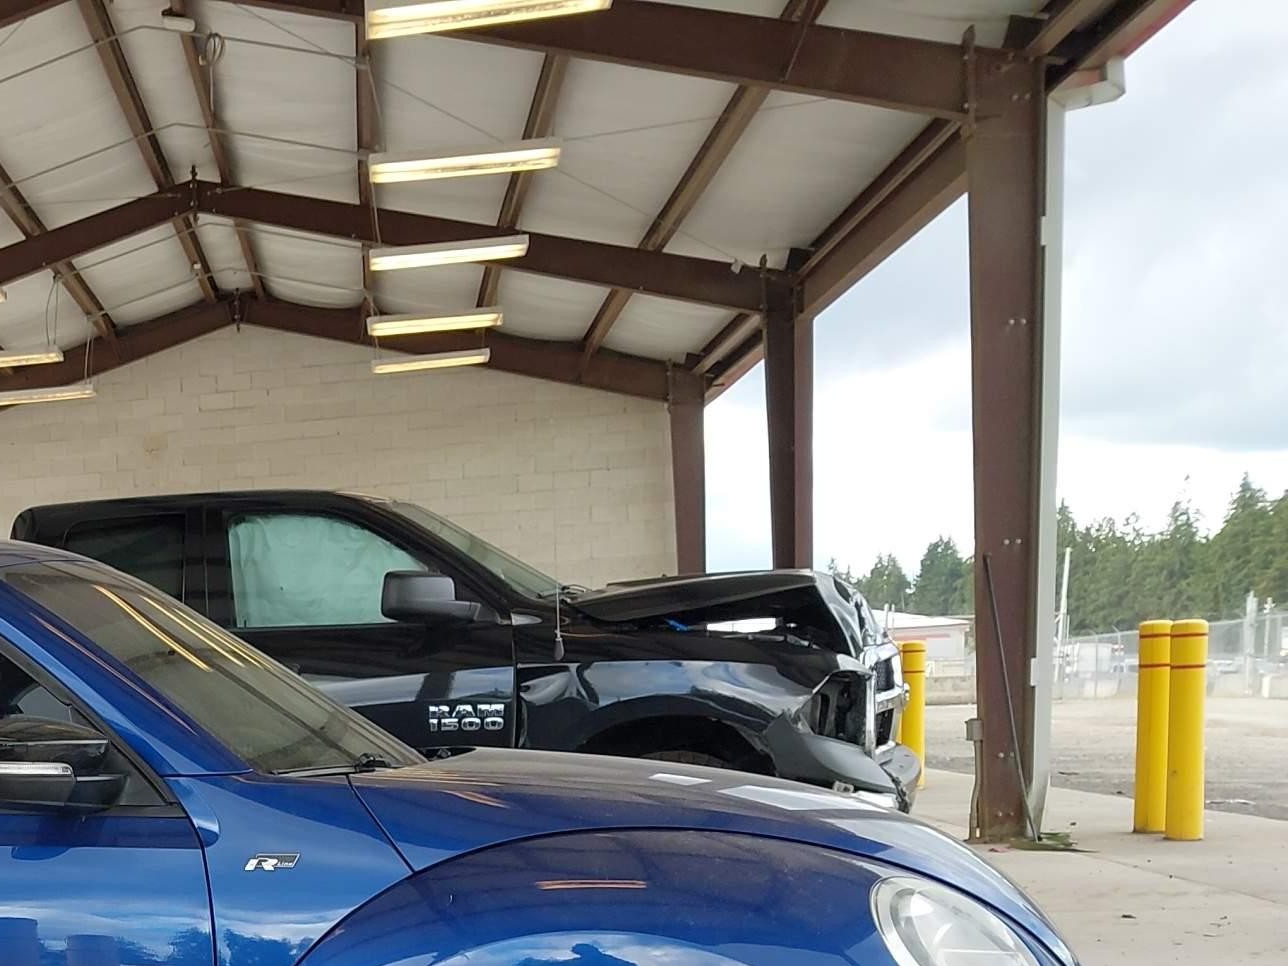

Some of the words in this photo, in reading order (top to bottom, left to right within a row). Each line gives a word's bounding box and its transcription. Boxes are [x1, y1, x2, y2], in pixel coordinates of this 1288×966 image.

[428, 703, 505, 718] RAM
[429, 717, 504, 731] 1500
[244, 857, 279, 871] R
